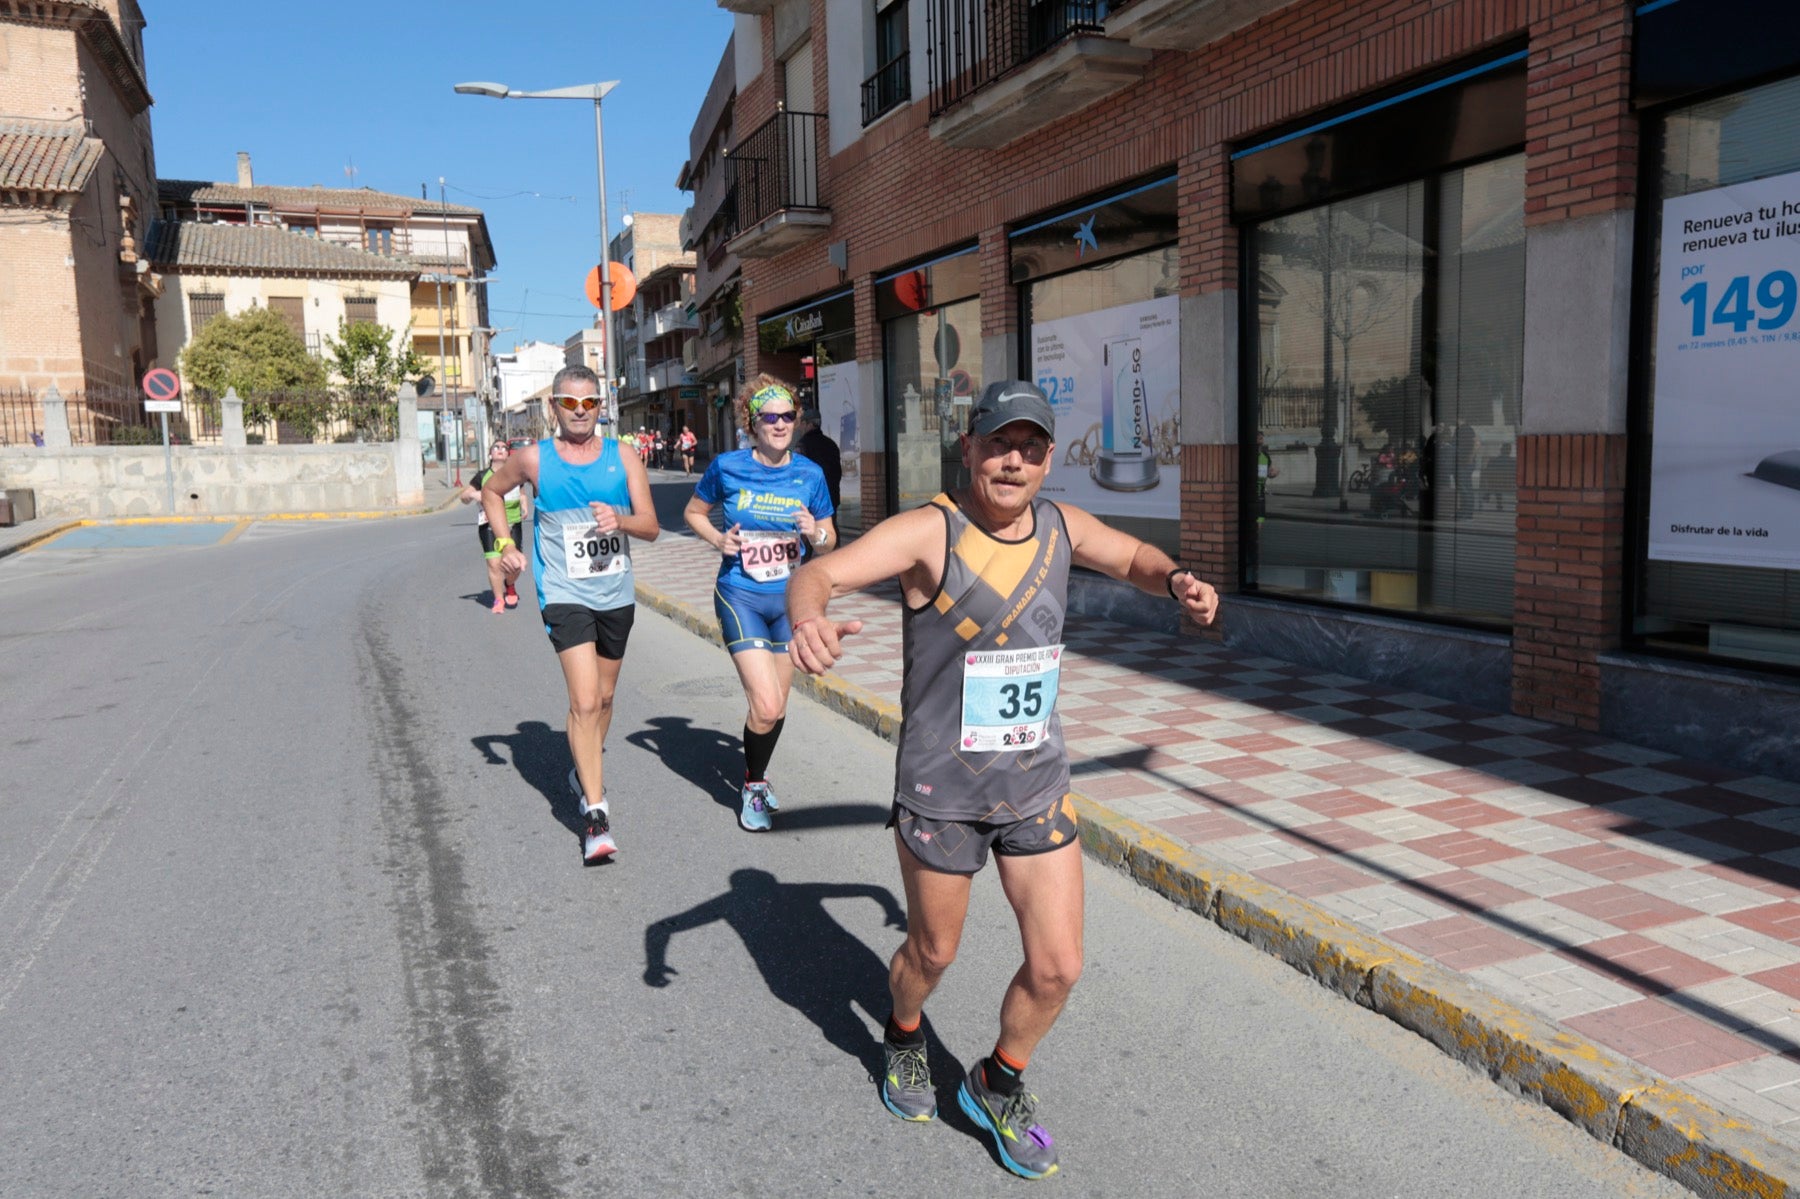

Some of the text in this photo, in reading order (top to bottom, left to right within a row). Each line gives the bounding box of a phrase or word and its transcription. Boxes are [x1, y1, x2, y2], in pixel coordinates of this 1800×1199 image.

[1683, 211, 1753, 235] Renueva
[1758, 207, 1776, 220] tu
[1682, 231, 1747, 253] renueva
[1753, 227, 1770, 241] tu
[1681, 264, 1705, 280] por
[1680, 269, 1798, 337] 149
[794, 310, 823, 334] CaixaBank
[1133, 348, 1141, 374] 5G
[752, 503, 784, 512] deportes
[756, 493, 801, 508] olimpo
[1671, 524, 1769, 538] Disfrutar de la vida
[573, 536, 620, 558] 3090
[747, 541, 799, 566] 2098
[1002, 585, 1037, 628] GRANADA
[1038, 566, 1048, 580] EL
[995, 654, 1014, 664] GRAN
[1016, 652, 1037, 664] PREMIO
[1038, 652, 1045, 660] DE
[998, 681, 1042, 720] 35
